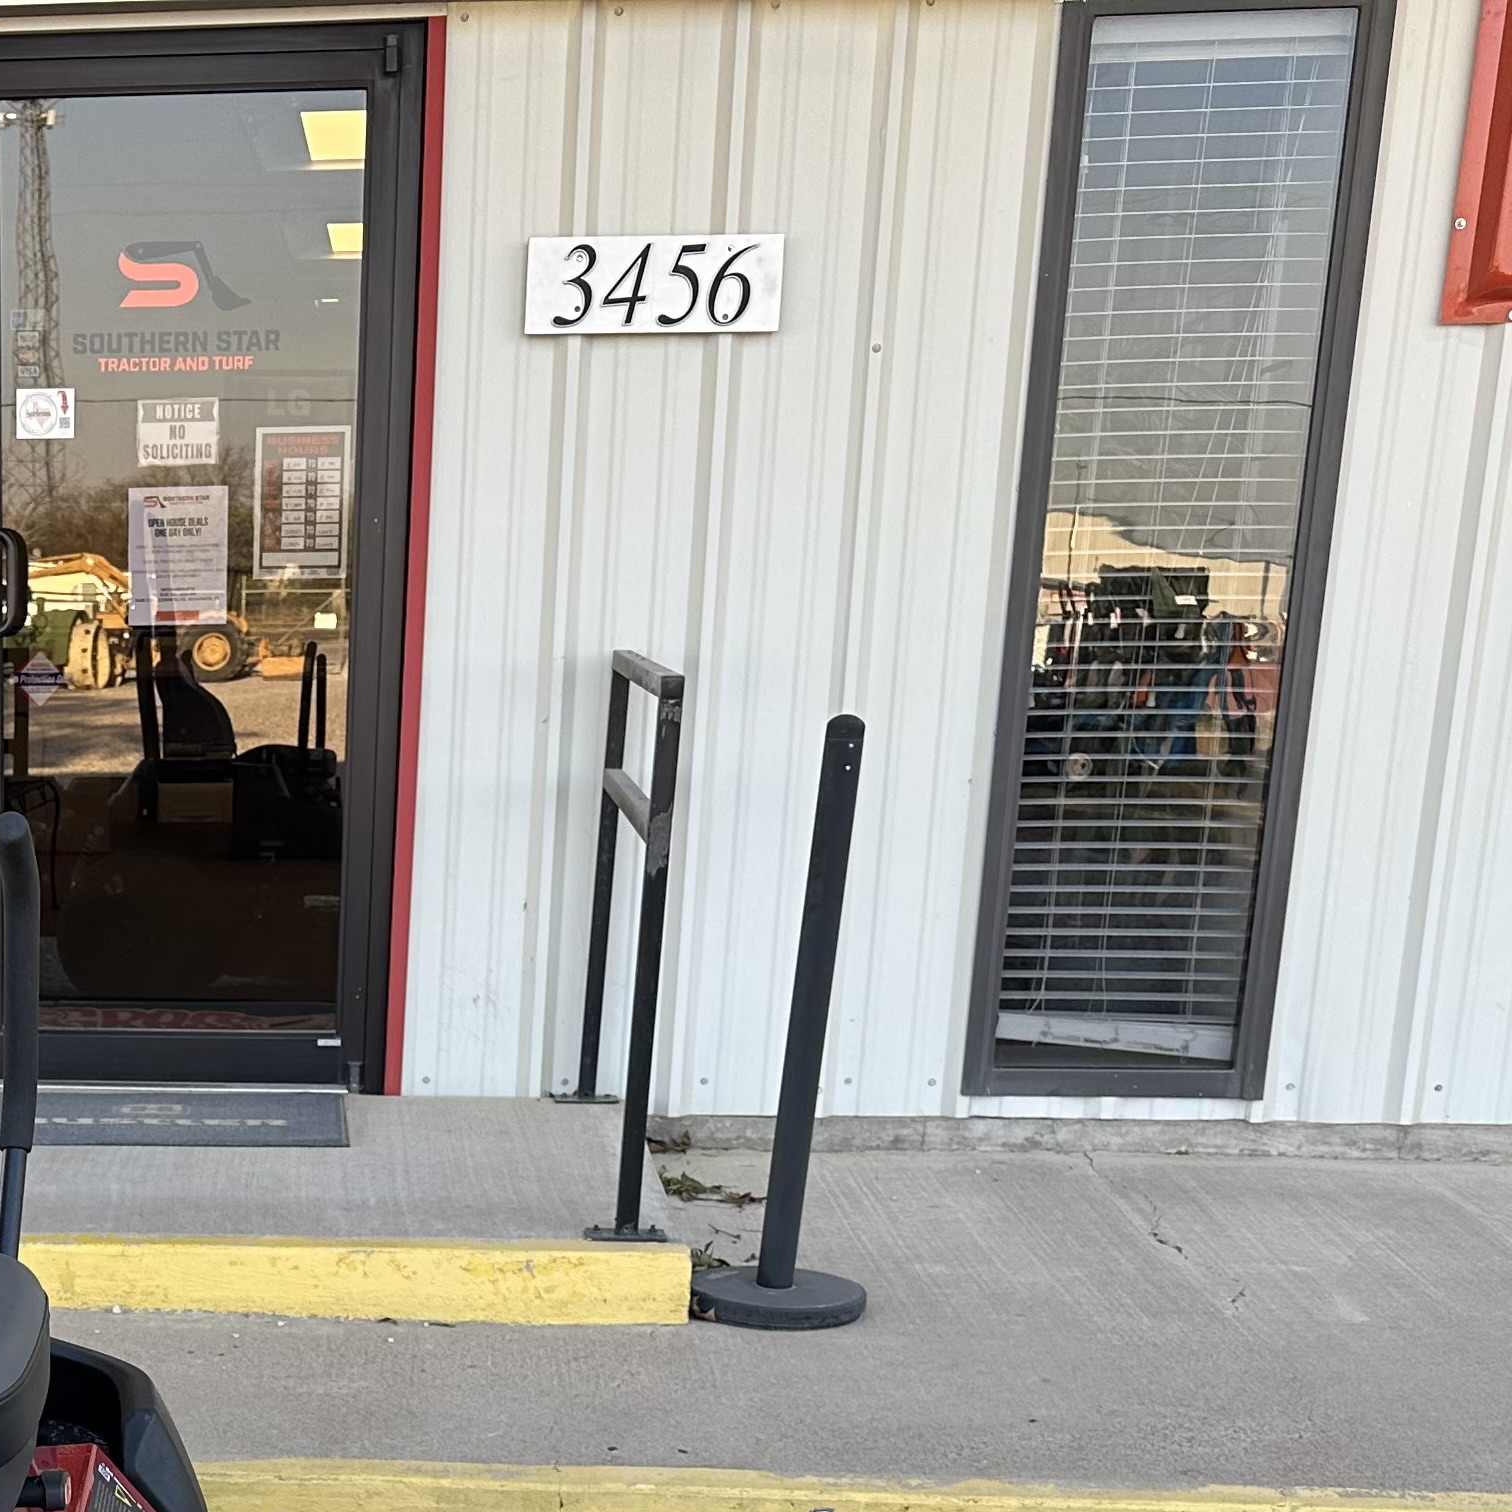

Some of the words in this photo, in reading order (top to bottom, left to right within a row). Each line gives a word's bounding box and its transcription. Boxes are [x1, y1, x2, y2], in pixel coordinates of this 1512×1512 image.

[551, 242, 761, 328] 3456
[72, 330, 208, 354] SOUTHERN
[215, 329, 281, 352] STAR
[97, 357, 171, 373] TRACTOR
[175, 356, 209, 372] AND
[212, 355, 255, 371] TURF
[155, 404, 202, 420] NOTICE
[168, 424, 185, 441] NO
[267, 434, 339, 446] BUSINESS
[142, 442, 213, 461] SOLICITING
[277, 445, 329, 455] HOURS
[148, 518, 165, 527] OPEN
[166, 517, 187, 527] HOUSE
[188, 516, 209, 527] DEALS
[154, 528, 167, 538] ONE
[168, 528, 181, 537] DAY
